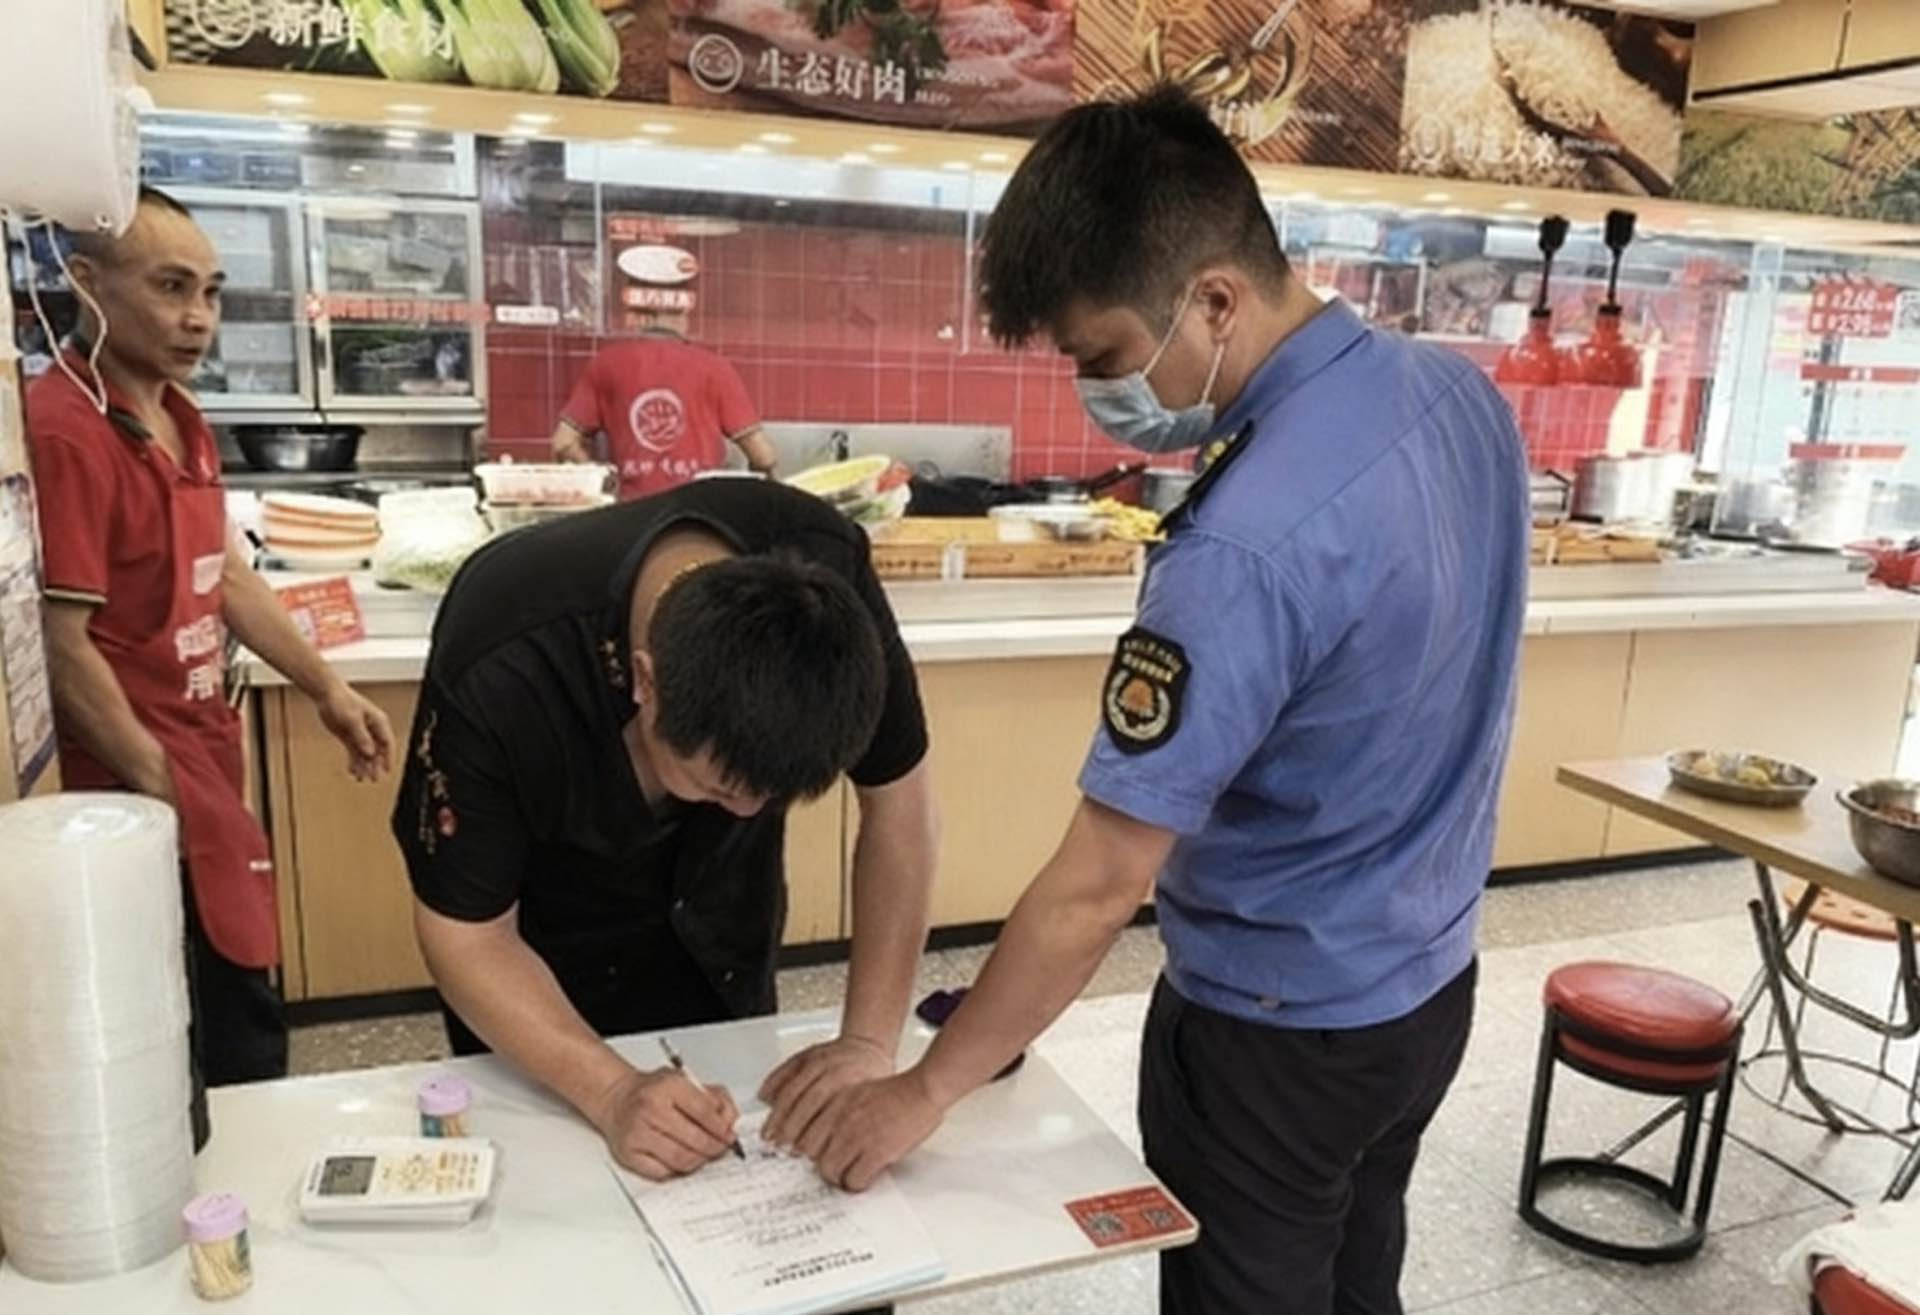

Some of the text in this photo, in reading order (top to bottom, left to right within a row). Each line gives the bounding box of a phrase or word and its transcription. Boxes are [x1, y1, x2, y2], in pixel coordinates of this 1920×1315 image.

[266, 0, 454, 60] 新鲜食材
[755, 47, 906, 104] 生态好肉
